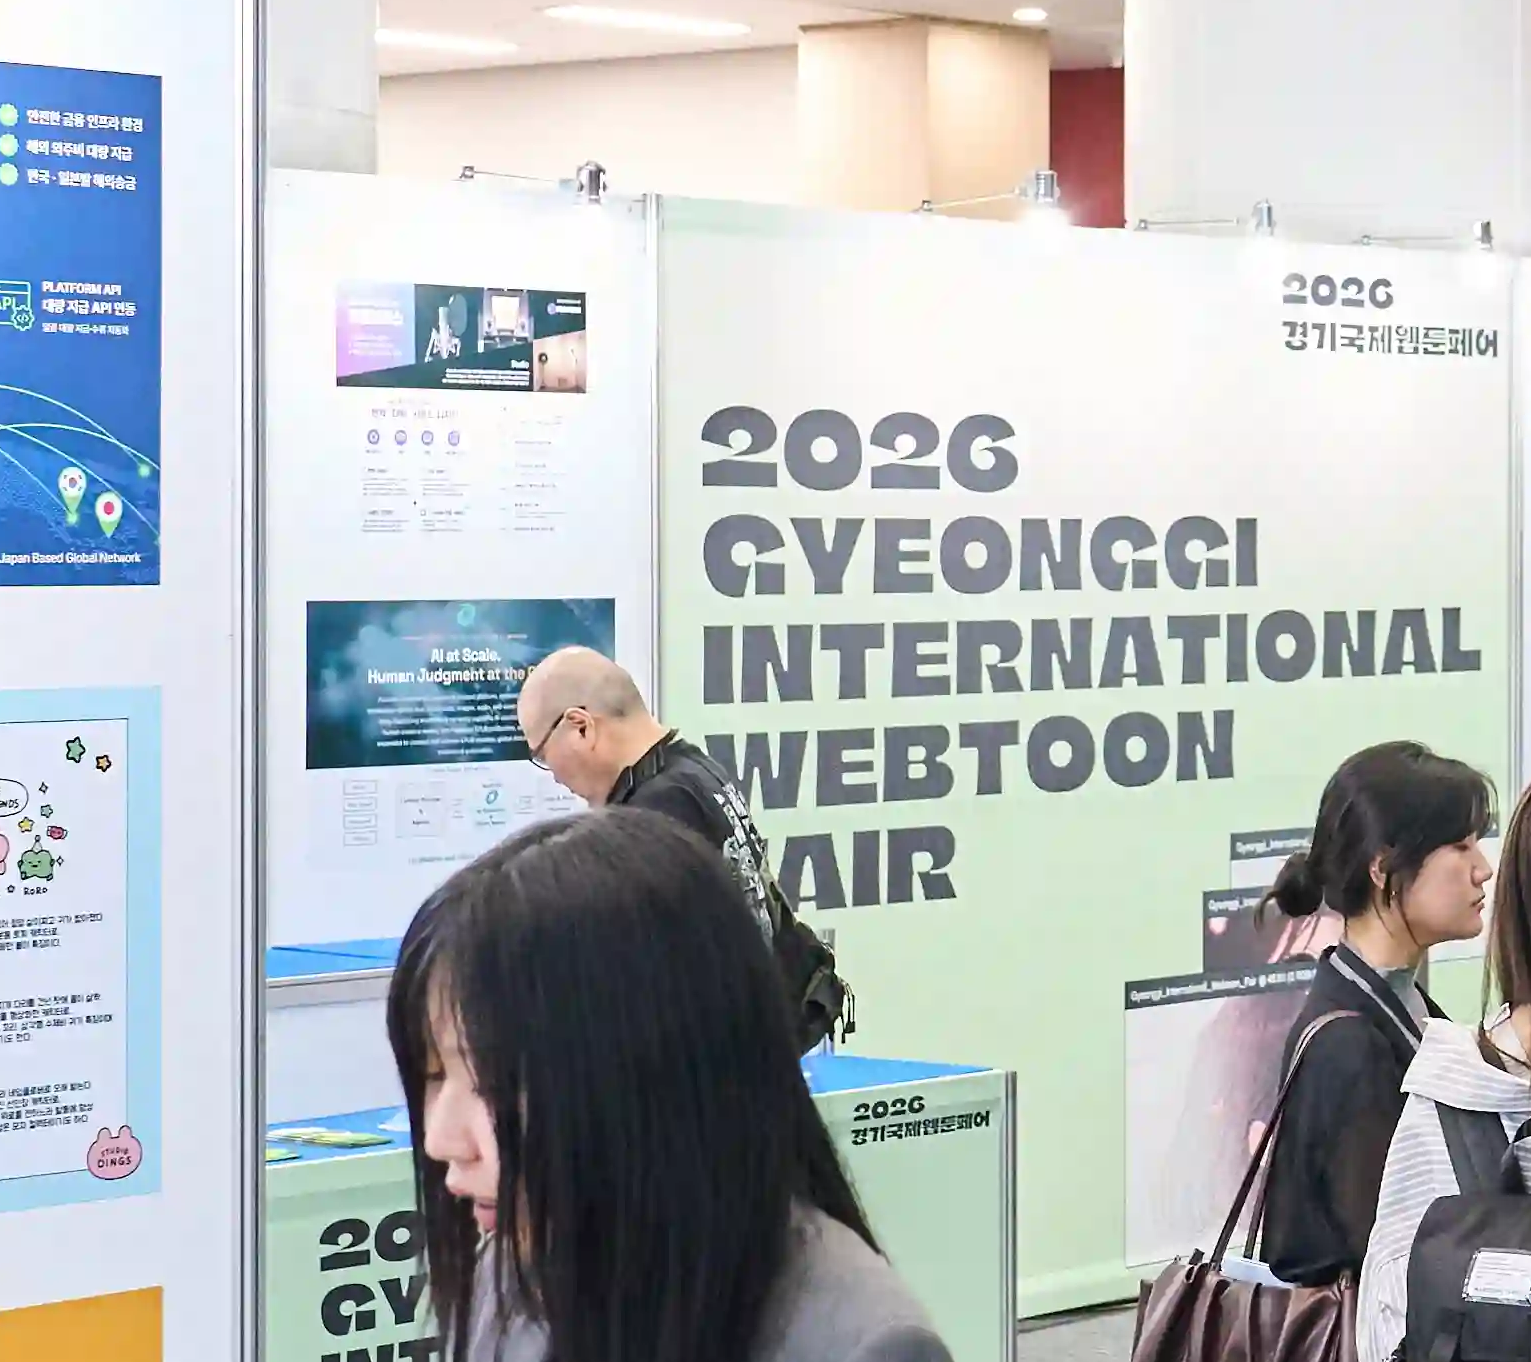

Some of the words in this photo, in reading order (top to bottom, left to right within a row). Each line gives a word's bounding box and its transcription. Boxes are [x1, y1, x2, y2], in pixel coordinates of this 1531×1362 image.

[91, 301, 111, 314] API
[1282, 272, 1394, 310] 2026
[1281, 320, 1499, 358] 경기국제웹툰페어
[701, 405, 1019, 493] 2026
[32, 552, 64, 564] Based
[65, 552, 98, 564] Global
[99, 552, 142, 564] Network
[703, 514, 1258, 598] GYEONGGI
[430, 649, 445, 663] AI
[446, 650, 460, 663] at
[462, 647, 502, 663] Scale.
[703, 606, 1482, 705] INTERNATIONAL
[368, 669, 415, 684] Human
[417, 668, 485, 686] Judgment
[486, 668, 501, 681] at
[503, 667, 526, 681] the
[703, 709, 1235, 812] WEBTOON
[764, 825, 958, 914] AIR
[853, 1095, 926, 1122] 2026
[851, 1110, 991, 1146] 경기국제웹툰페어
[97, 1155, 132, 1169] DINGS
[319, 1209, 426, 1272] 20
[320, 1274, 428, 1337] GY
